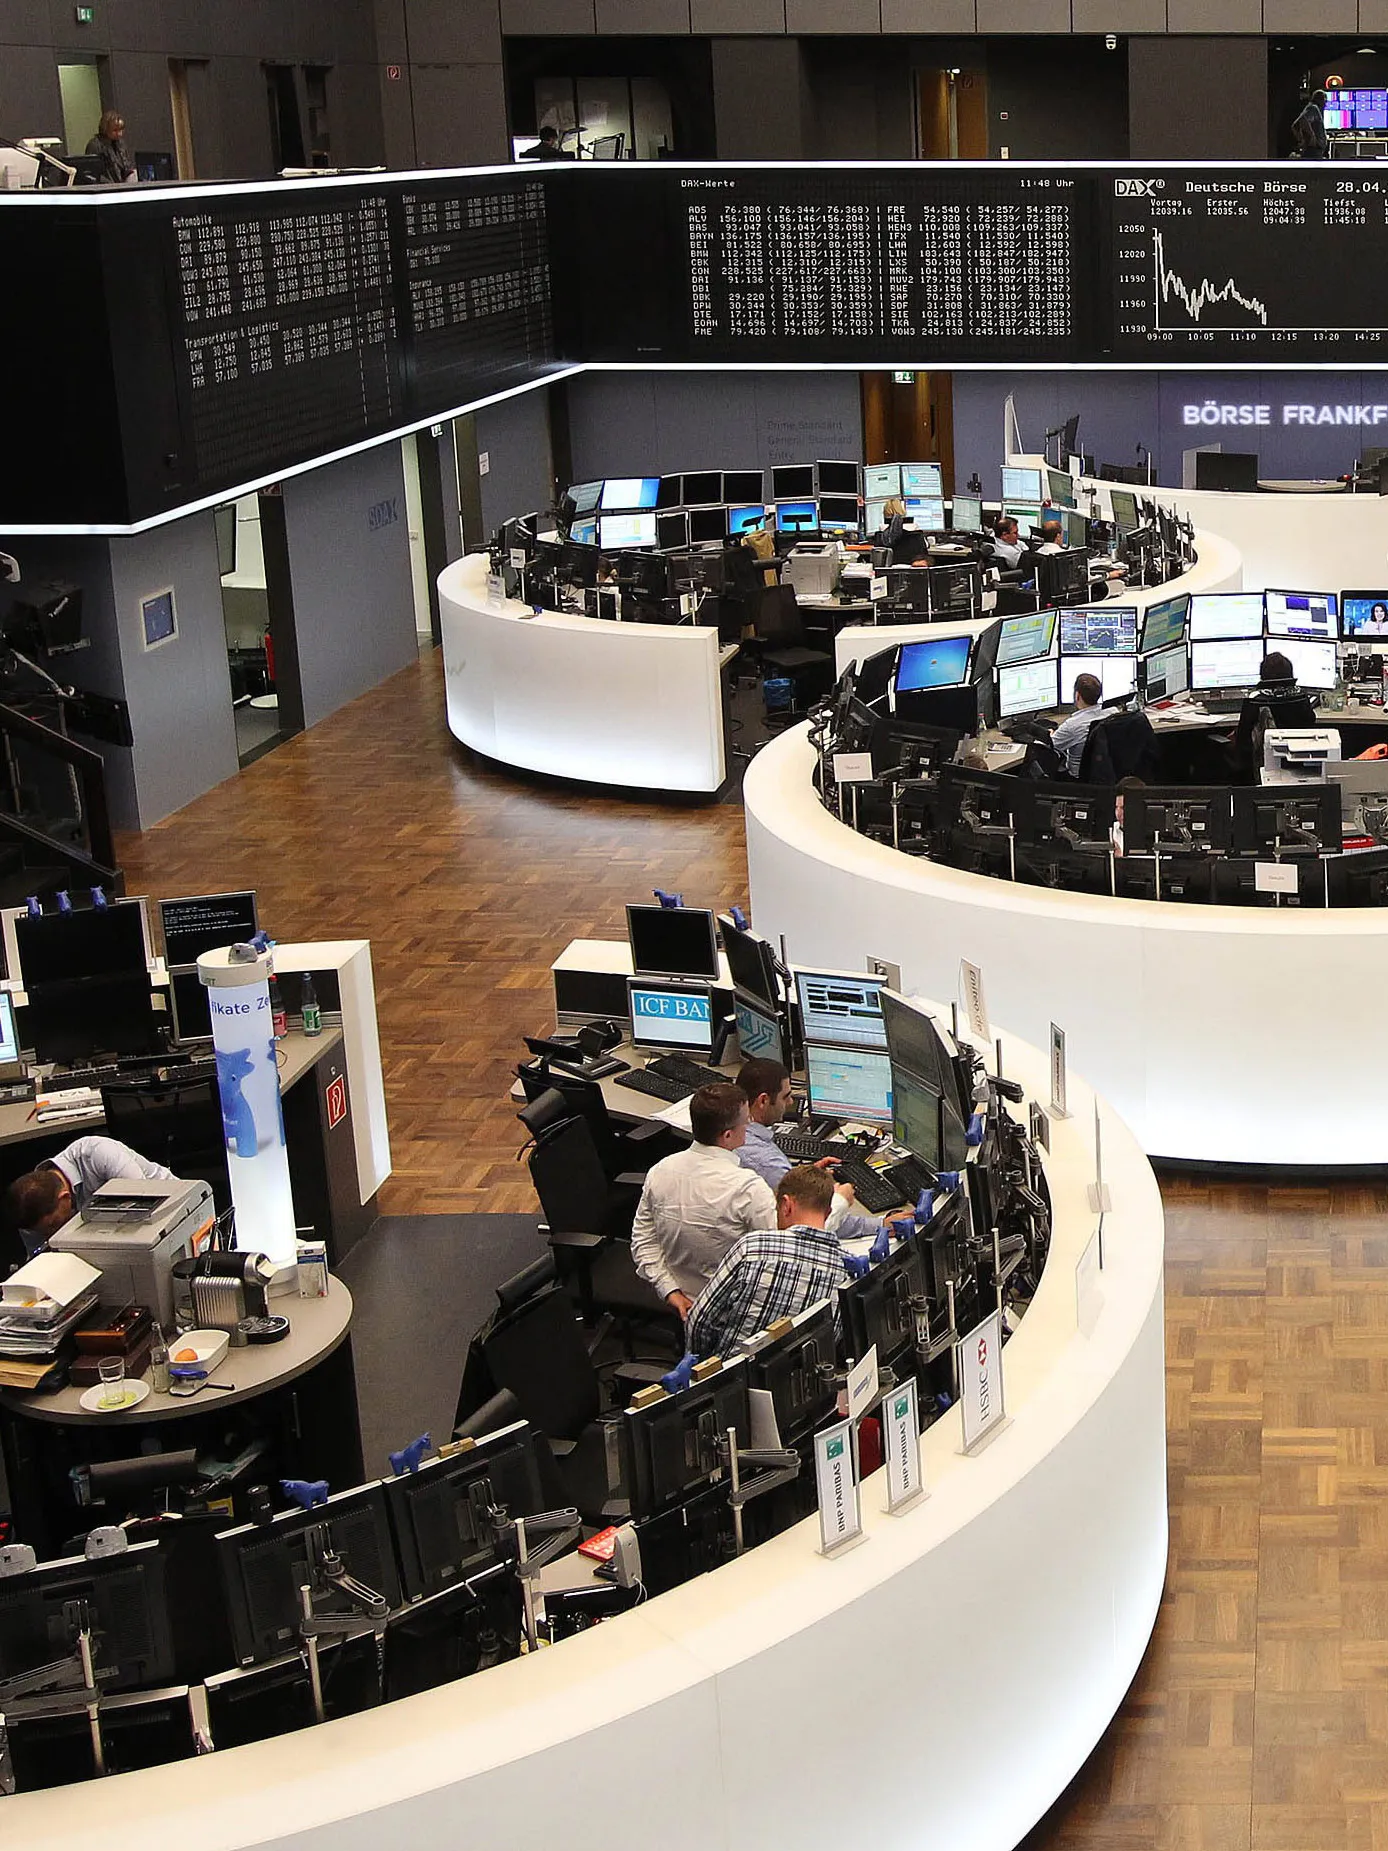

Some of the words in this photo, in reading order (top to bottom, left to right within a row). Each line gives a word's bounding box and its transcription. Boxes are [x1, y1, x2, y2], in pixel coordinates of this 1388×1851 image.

[1186, 182, 1254, 192] Deutsche
[1264, 181, 1306, 192] Börse
[1151, 199, 1184, 209] Vortag
[1207, 199, 1238, 208] Erster
[1264, 199, 1294, 208] Höchst
[173, 215, 211, 227] Automobile
[1264, 216, 1304, 224] 09:04:39
[185, 331, 238, 348] Transportation
[1147, 332, 1172, 340] 09:00
[1189, 332, 1213, 340] 10:05
[1272, 332, 1297, 340] 12:15
[1314, 332, 1339, 340] 13:20
[1356, 332, 1380, 340] 14:25
[215, 355, 236, 369] 12,750
[216, 368, 238, 382] 57,100
[1183, 401, 1271, 426] BÖRSE
[639, 996, 669, 1015] ICF
[979, 1369, 990, 1422] HSBC
[900, 1421, 908, 1466] PARIBAS
[833, 1462, 843, 1507] PARIBAS
